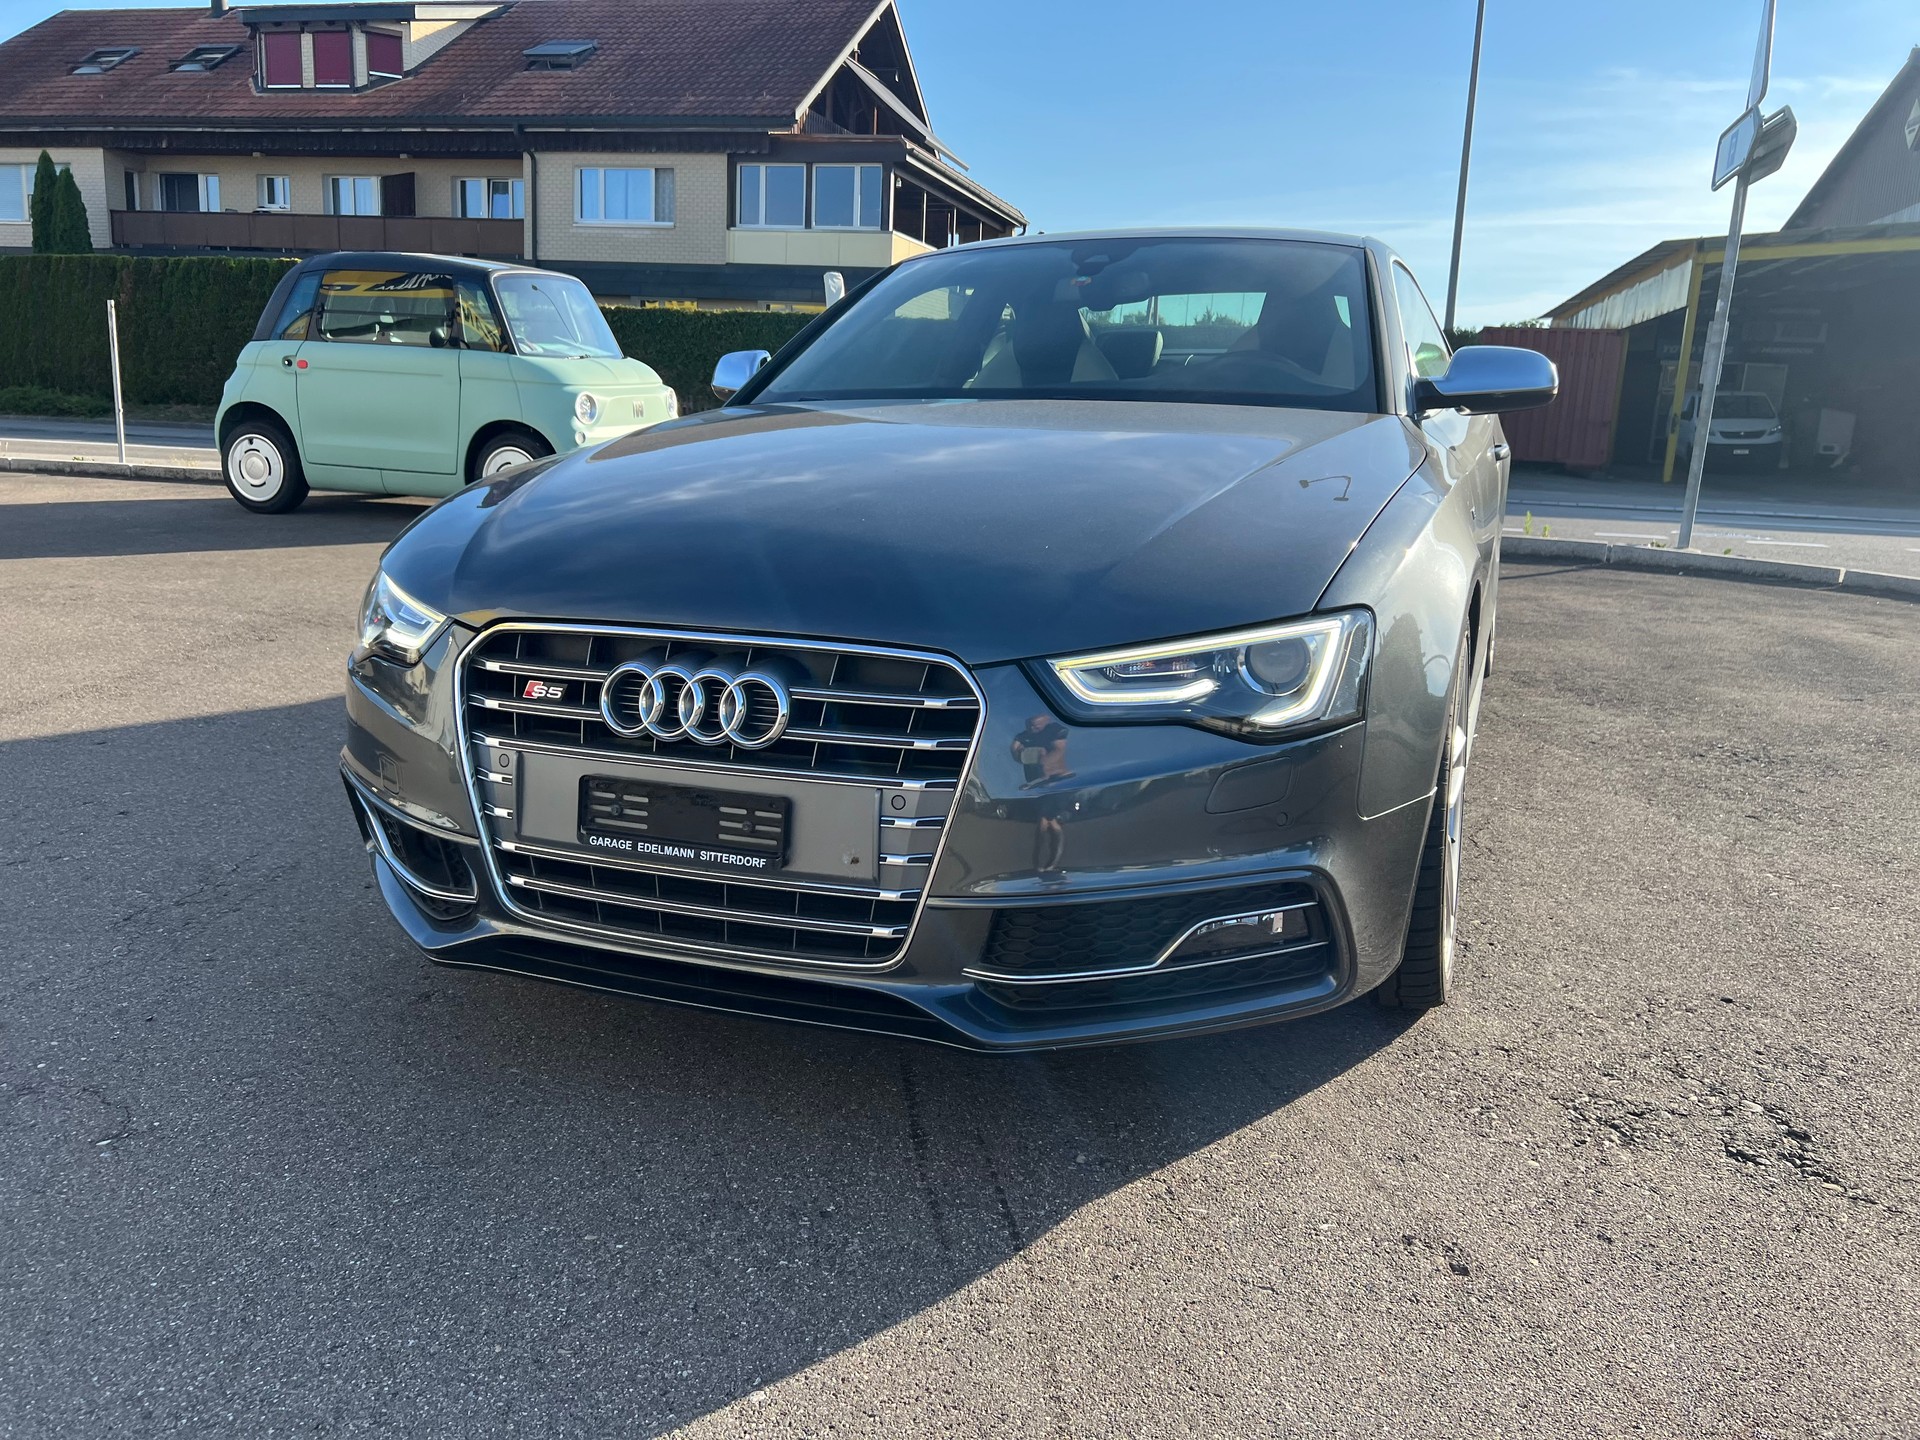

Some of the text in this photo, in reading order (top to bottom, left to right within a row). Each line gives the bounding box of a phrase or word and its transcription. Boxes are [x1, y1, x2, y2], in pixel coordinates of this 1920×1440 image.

[530, 684, 564, 699] S5
[589, 835, 767, 869] GARAGE EDELMANN SITTERDORF
